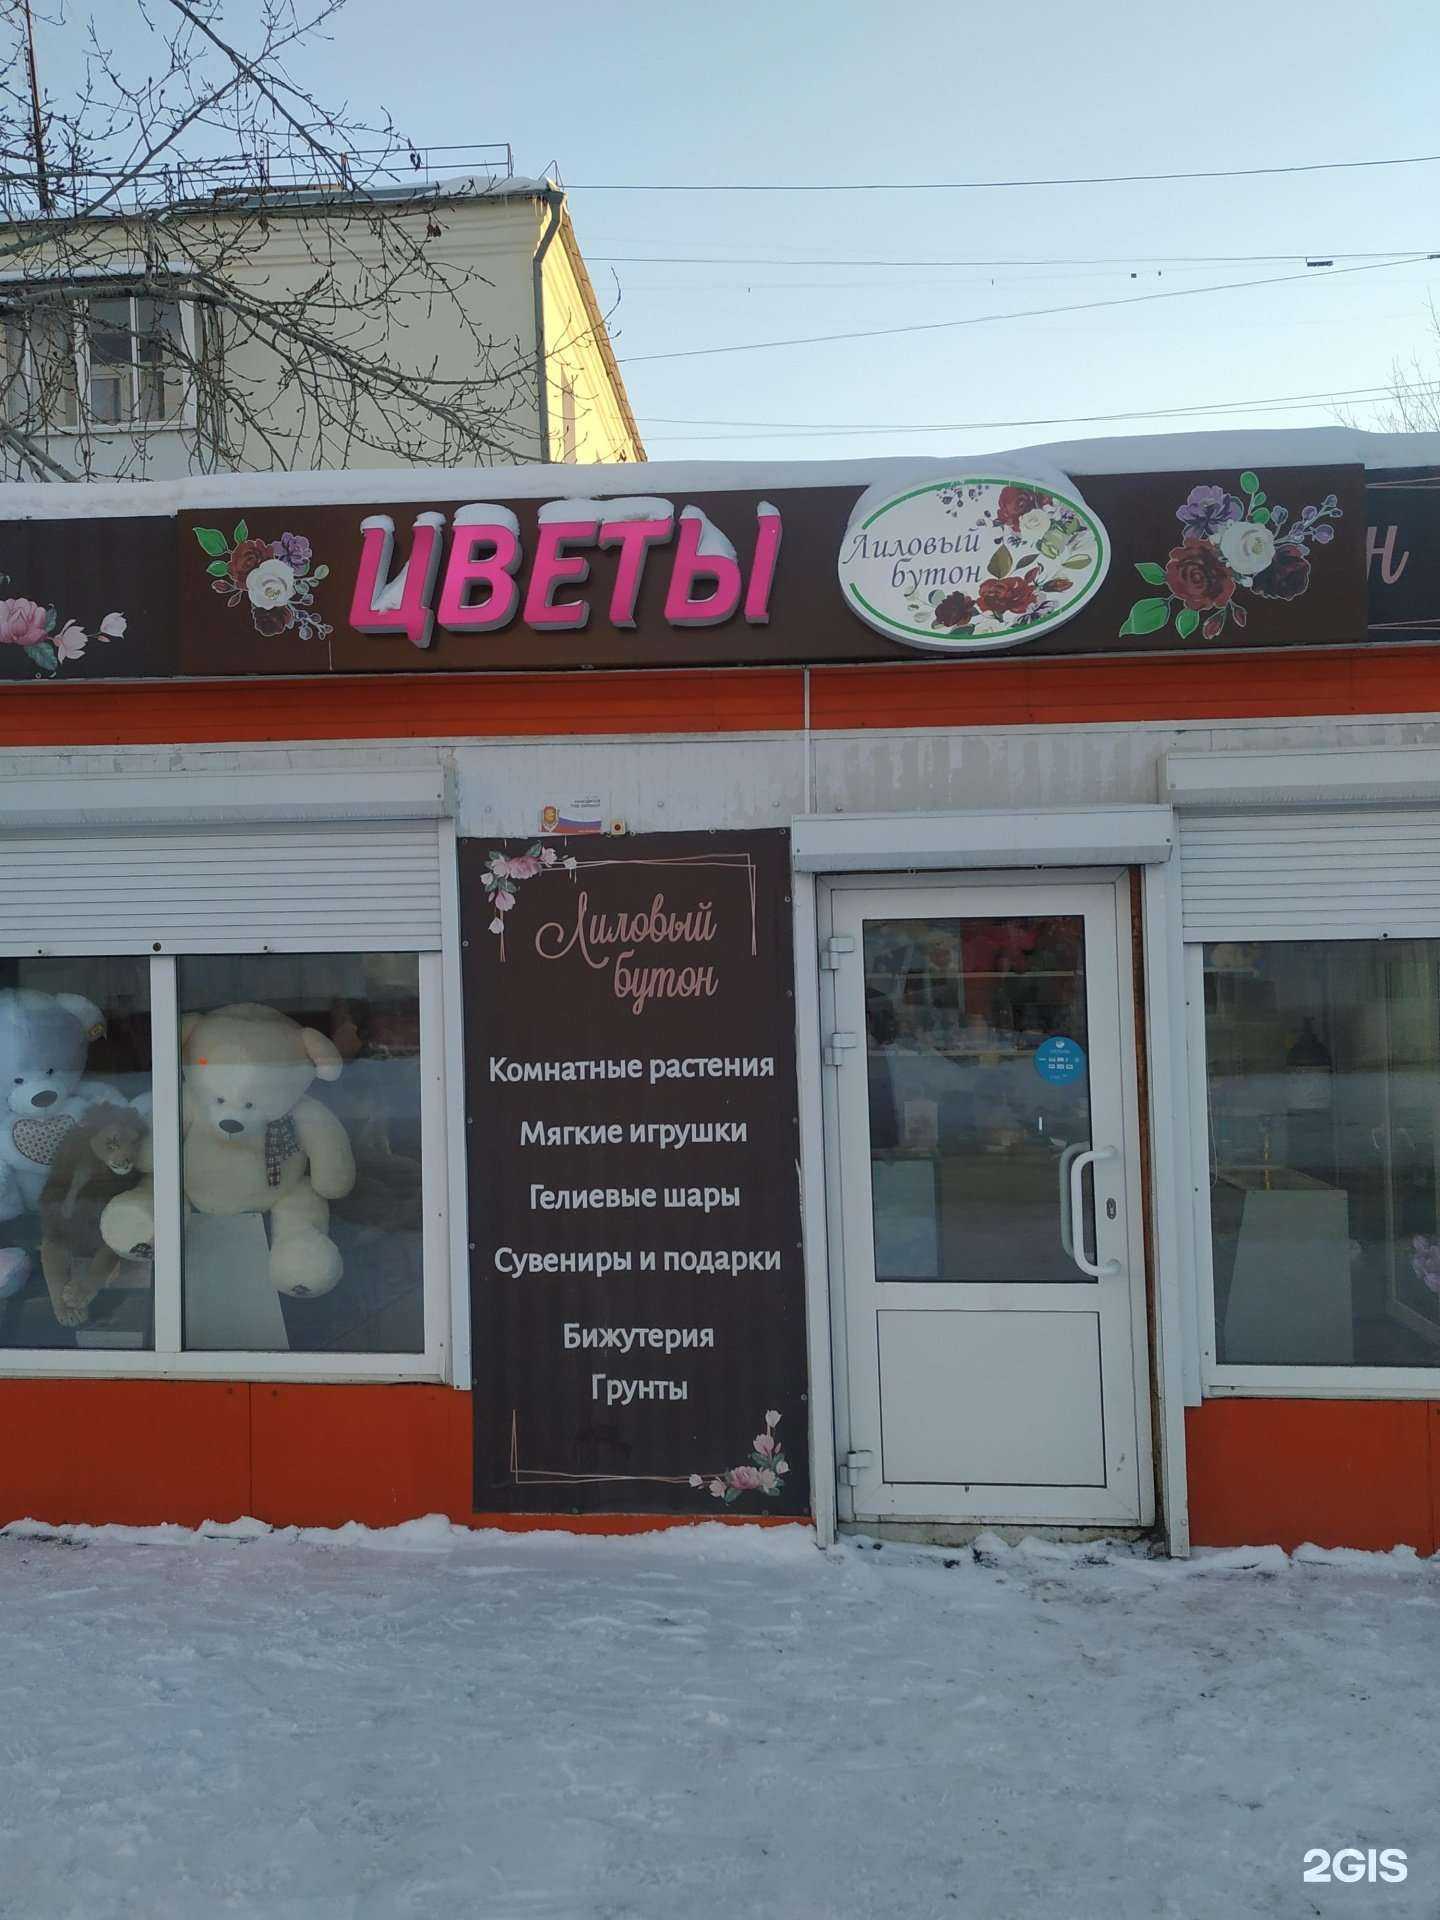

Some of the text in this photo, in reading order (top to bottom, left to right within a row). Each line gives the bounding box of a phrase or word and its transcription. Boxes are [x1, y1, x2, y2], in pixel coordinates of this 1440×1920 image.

[842, 528, 980, 565] Лиловый
[349, 513, 782, 649] ЦВЕТЫ
[891, 557, 981, 597] бутон
[535, 891, 717, 969] Лиловый
[613, 949, 719, 1015] бутон
[489, 1056, 775, 1084] Комнатные растения
[520, 1120, 748, 1149] Мягкие игрушки
[530, 1184, 741, 1213] Гелиевые шары
[494, 1247, 782, 1278] Сувениры и подарки
[563, 1322, 715, 1354] Бижутерия
[591, 1373, 689, 1405] Грунты
